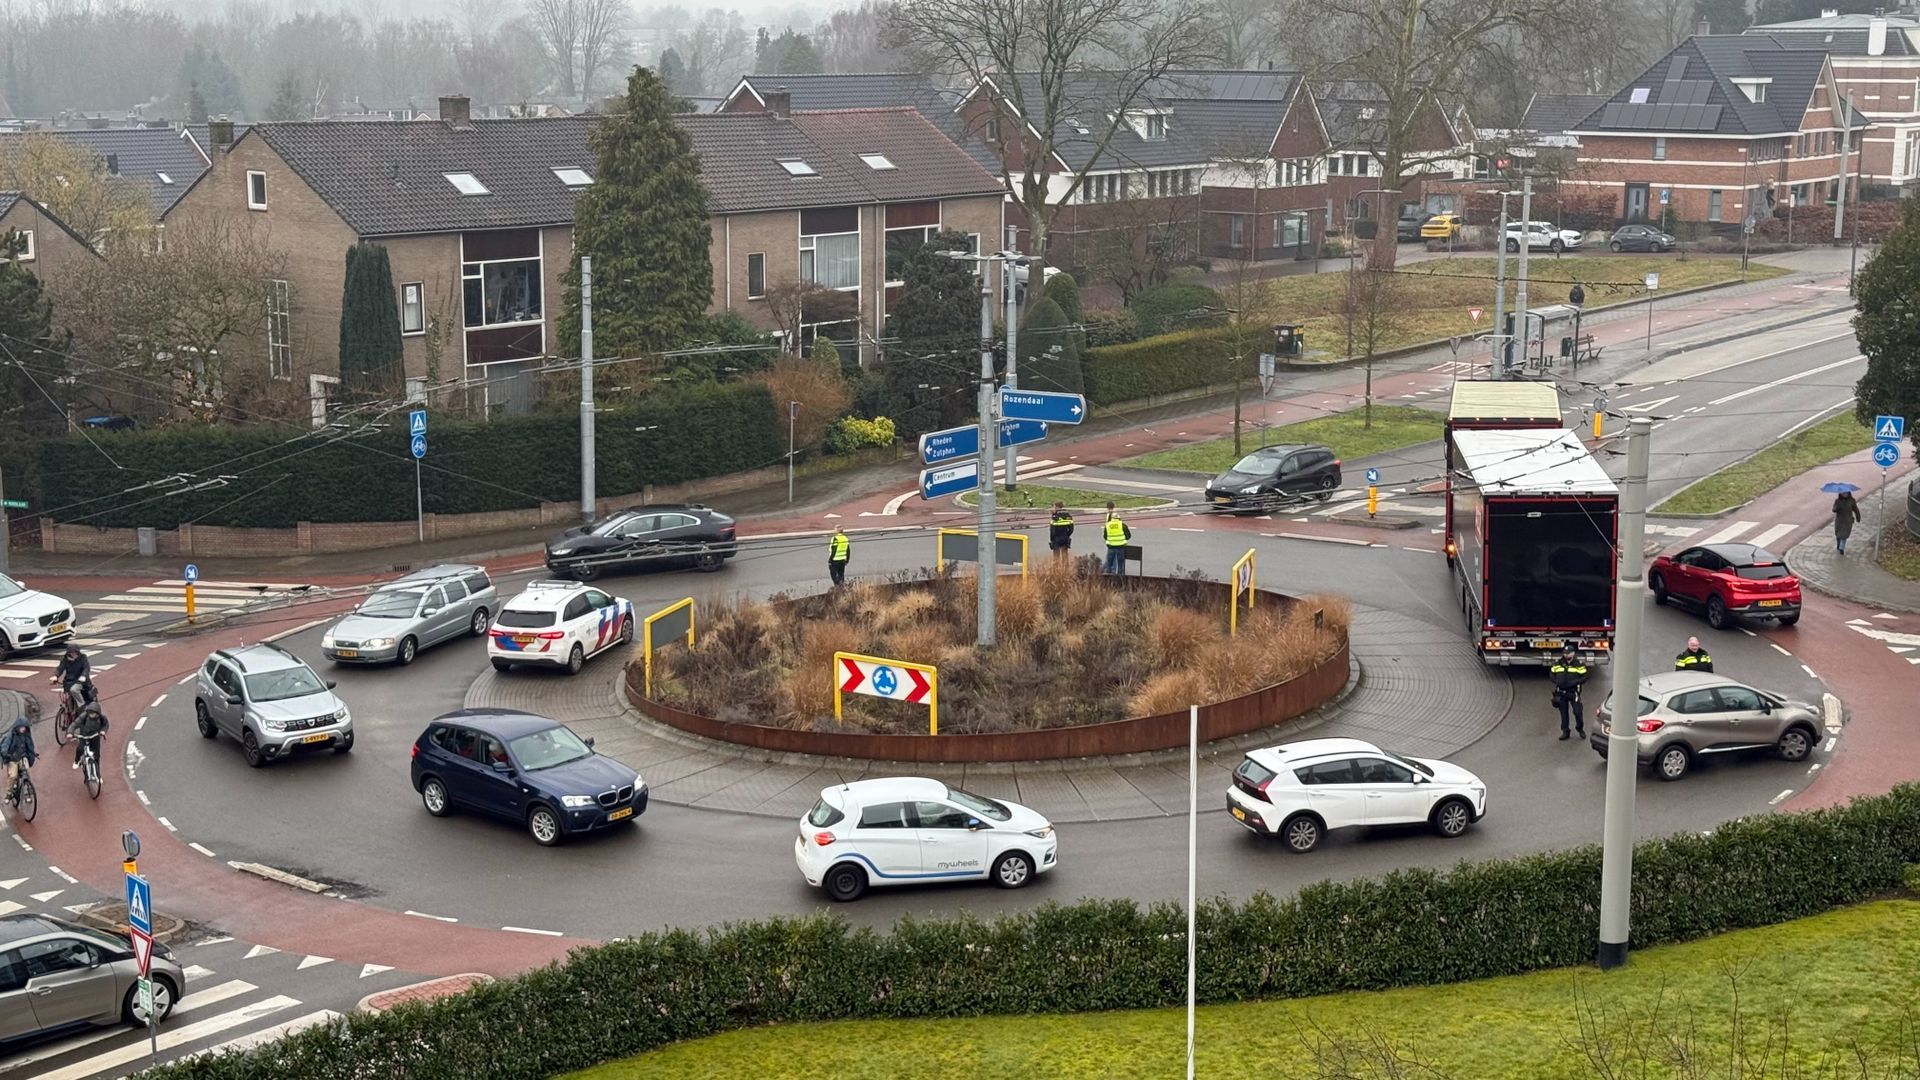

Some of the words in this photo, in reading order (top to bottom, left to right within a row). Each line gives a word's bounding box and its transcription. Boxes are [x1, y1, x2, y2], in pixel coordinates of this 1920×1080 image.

[1003, 394, 1044, 405] Rozendaal
[932, 436, 953, 446] Rheden
[932, 447, 956, 458] Zutphen
[933, 471, 956, 481] Centrum
[937, 859, 979, 869] mywheels
